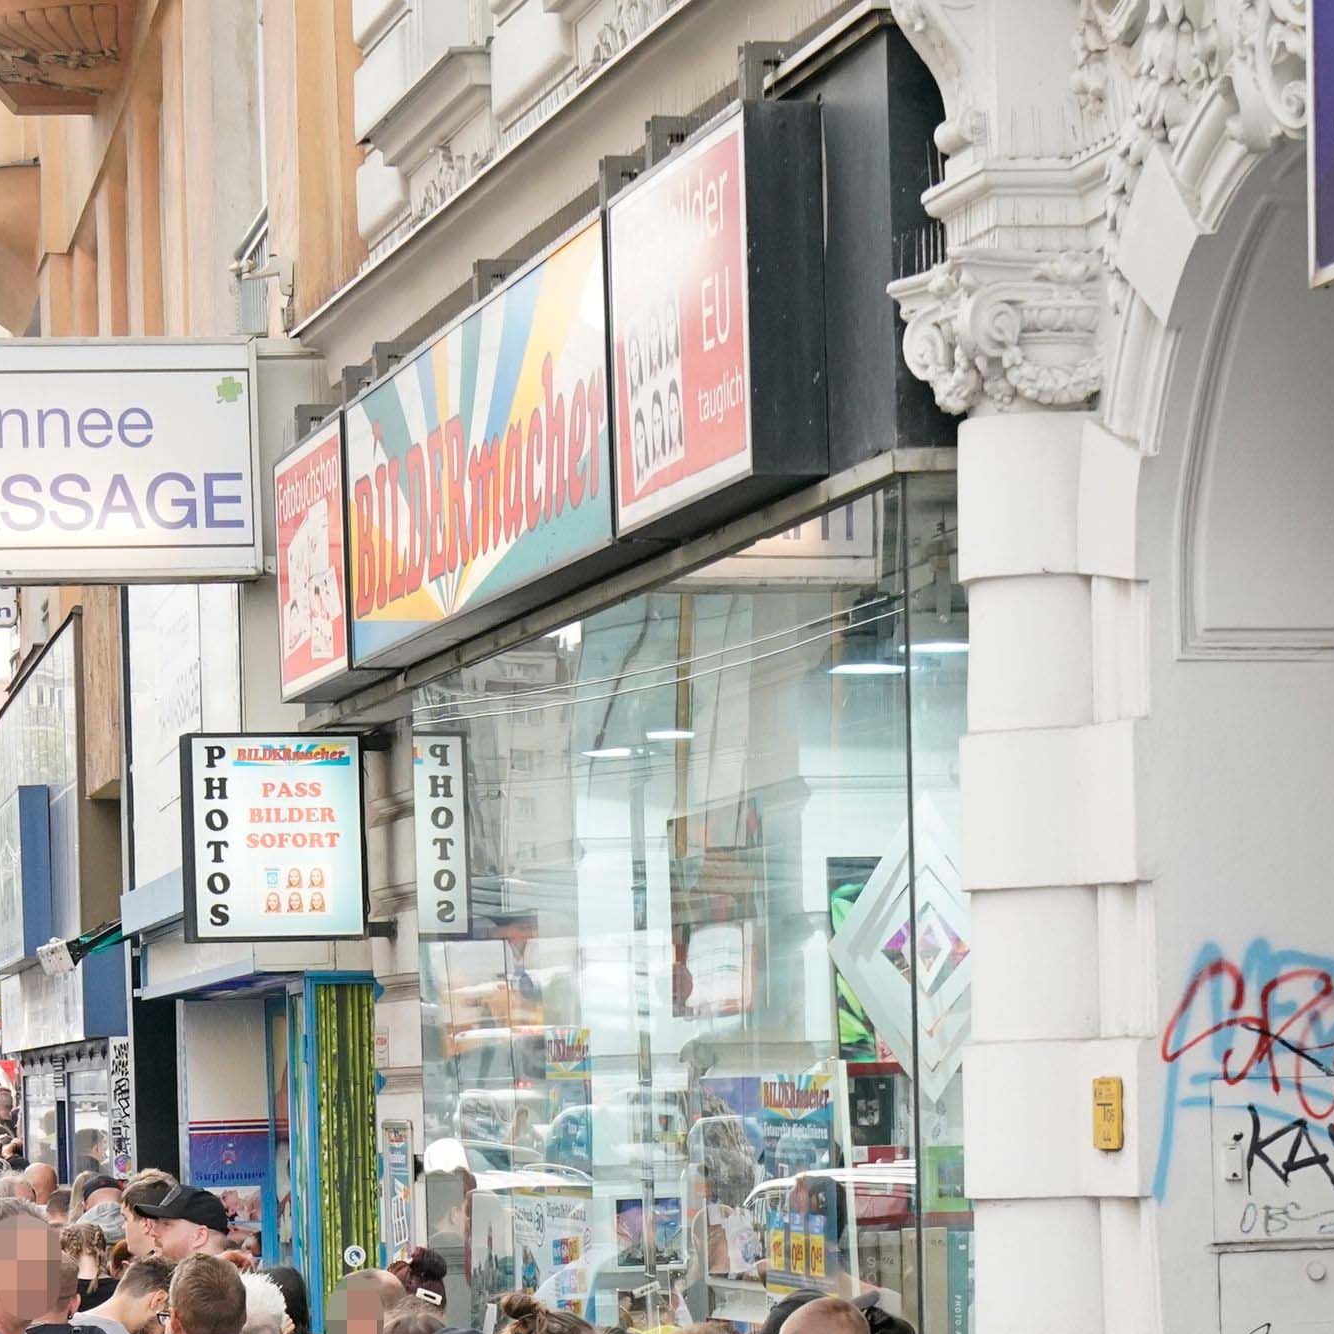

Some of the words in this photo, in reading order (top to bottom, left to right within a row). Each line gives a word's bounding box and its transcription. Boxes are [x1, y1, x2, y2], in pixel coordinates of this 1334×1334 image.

[702, 265, 730, 352] EU
[698, 365, 744, 425] tauglich
[277, 451, 338, 523] Fotobuchshop
[354, 352, 605, 619] BILDERmacher
[236, 747, 346, 762] BILDERmacher
[261, 782, 323, 798] PASS
[204, 745, 231, 927] PHOTOS
[249, 807, 336, 824] BILDER
[246, 832, 341, 849] SOFORT
[954, 1294, 962, 1326] PHOTO
